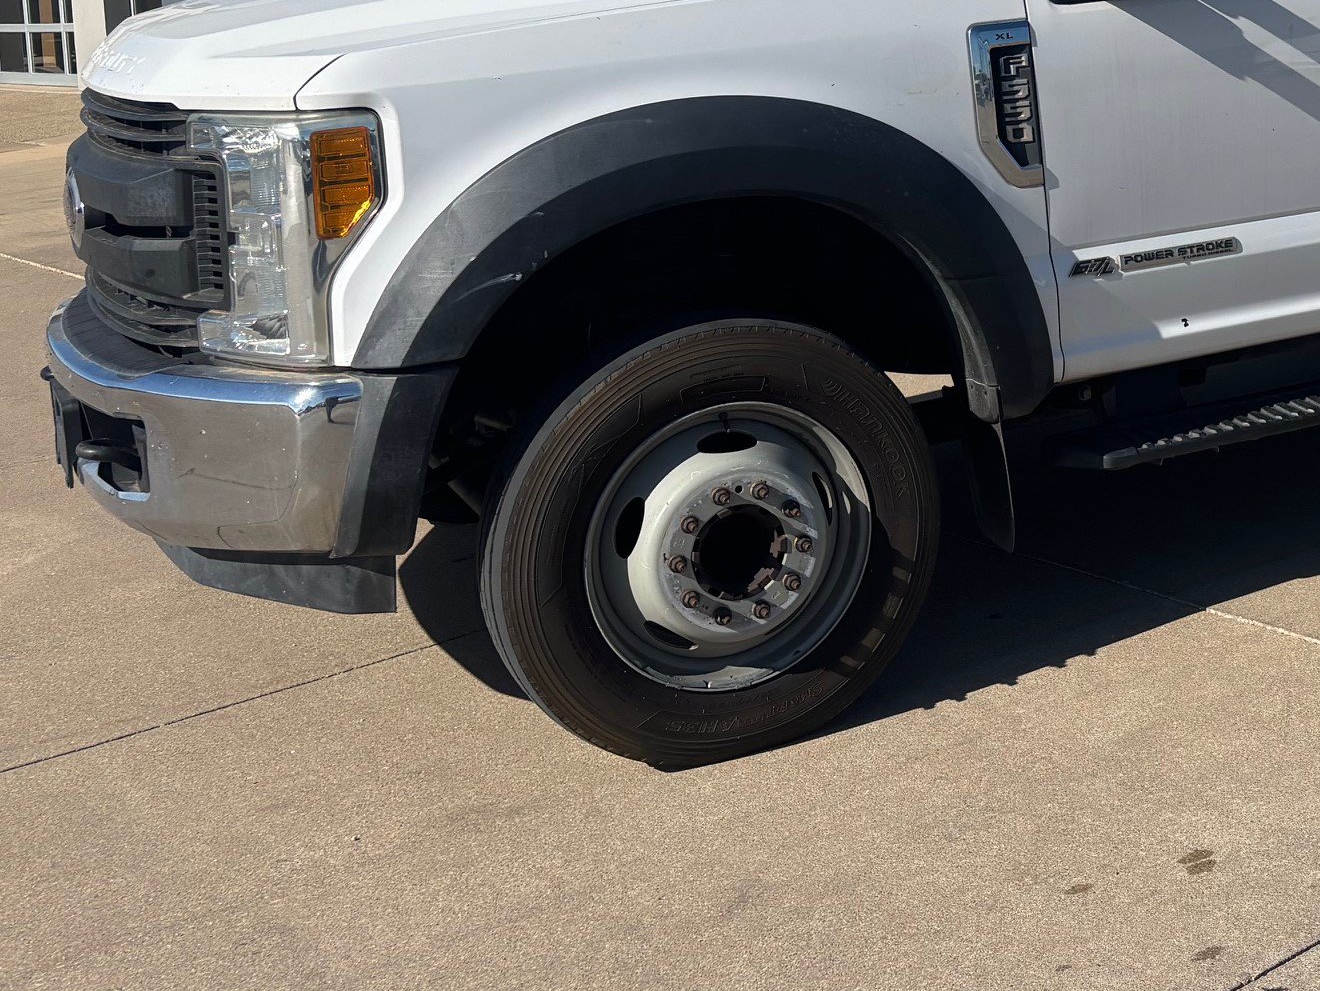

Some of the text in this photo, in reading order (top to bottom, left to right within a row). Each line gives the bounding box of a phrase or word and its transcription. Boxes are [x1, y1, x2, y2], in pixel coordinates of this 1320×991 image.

[995, 32, 1014, 41] XL
[1123, 249, 1175, 266] POWER
[1177, 238, 1234, 257] STROKE
